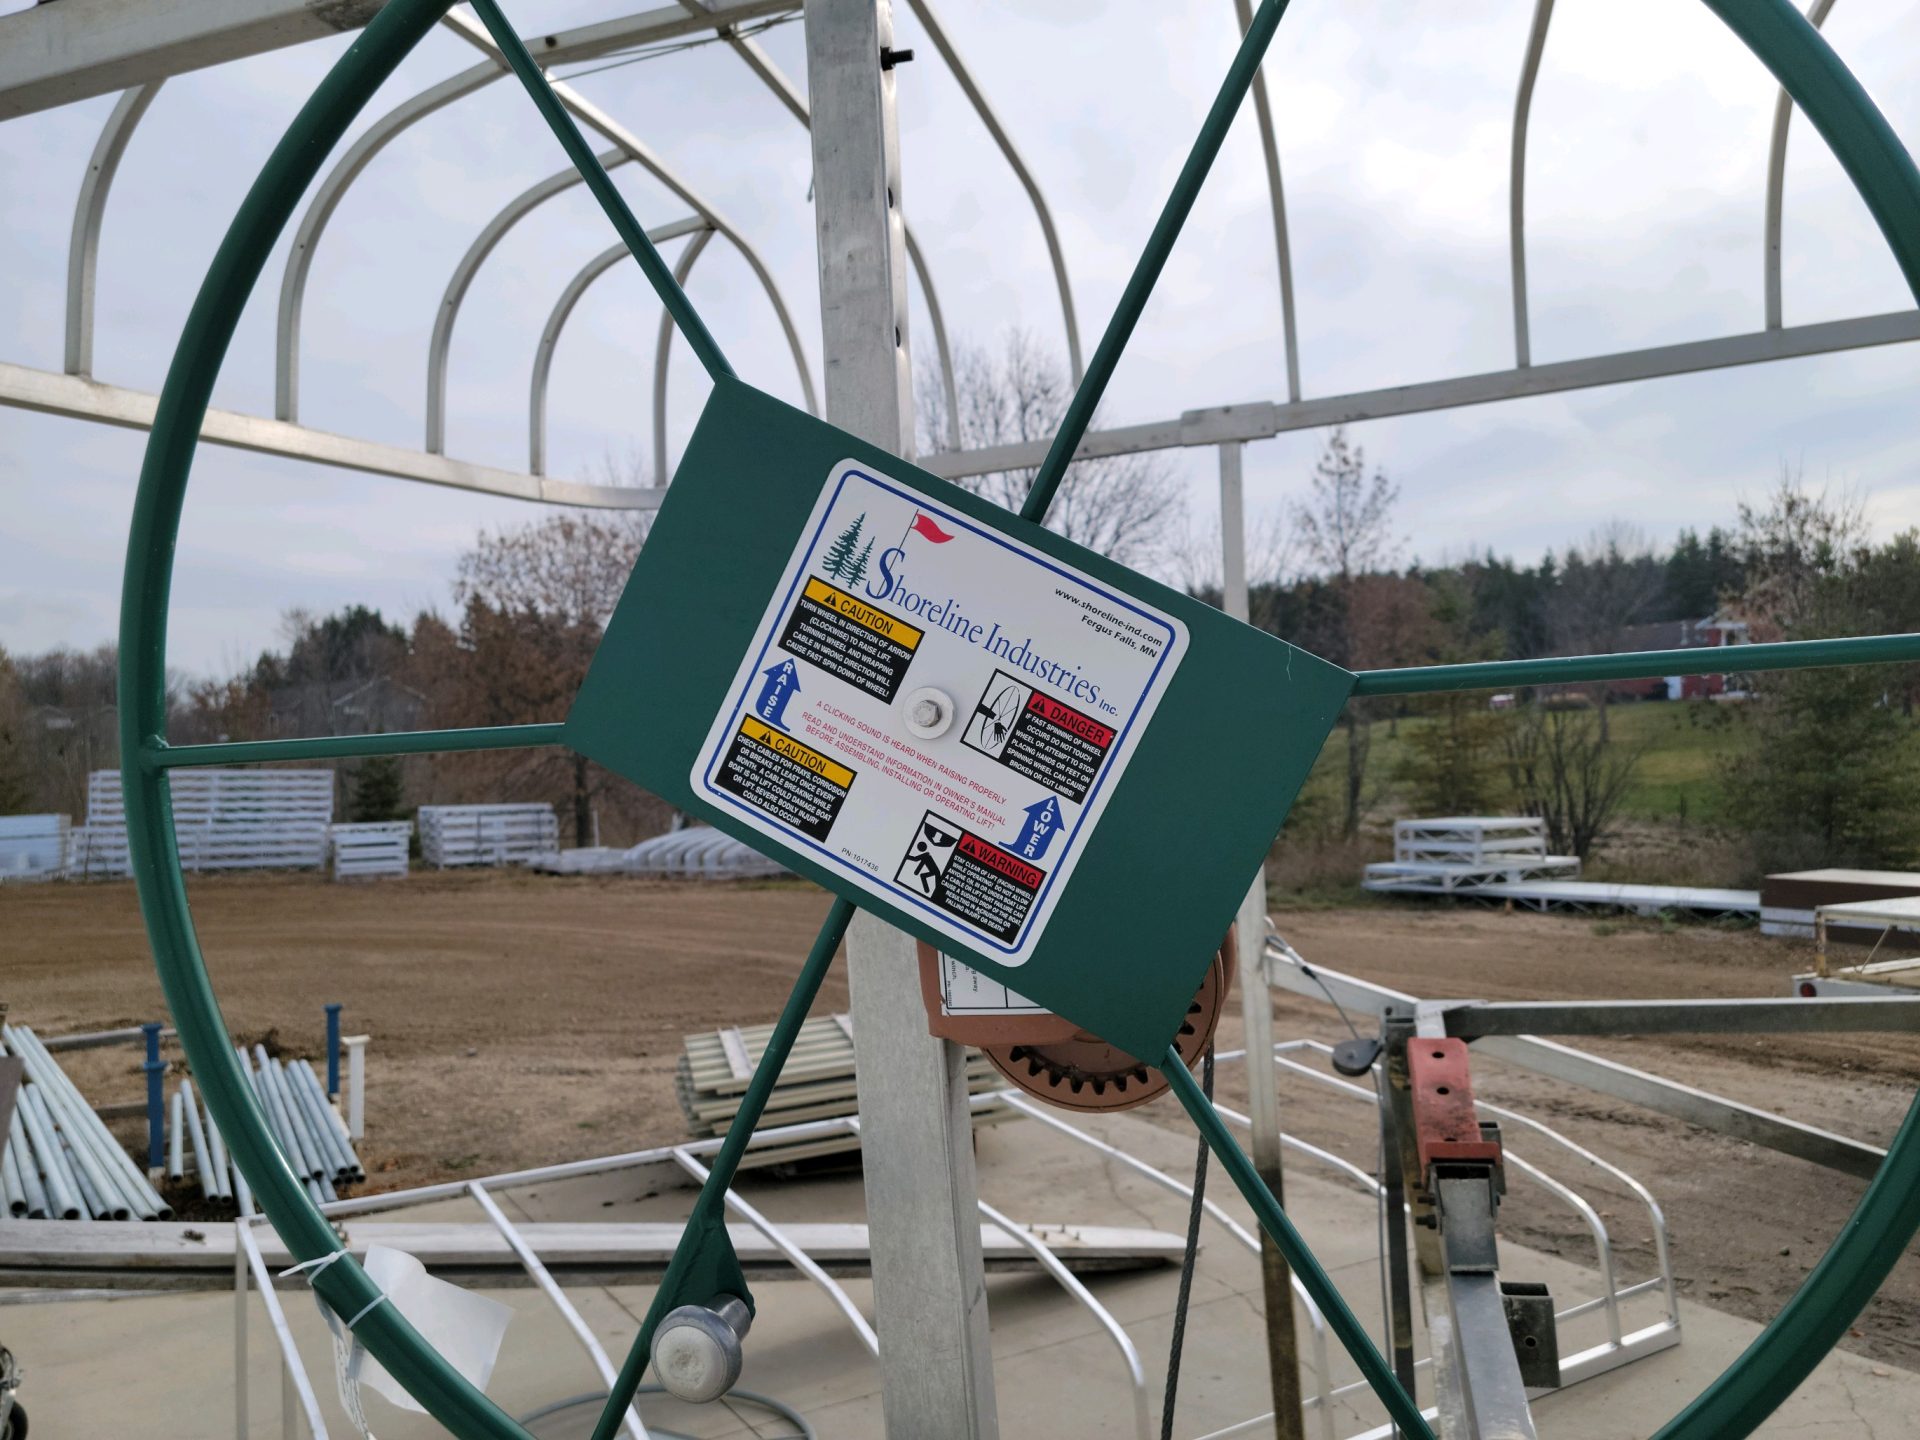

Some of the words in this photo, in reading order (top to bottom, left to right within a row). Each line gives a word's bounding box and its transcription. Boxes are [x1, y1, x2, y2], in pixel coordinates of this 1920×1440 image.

[799, 599, 817, 613] TURN
[816, 607, 839, 623] WHEEL
[837, 618, 846, 627] IN
[845, 622, 879, 644] DIRECTION
[877, 639, 888, 649] OF
[887, 643, 912, 661] ARROW
[809, 616, 849, 641] (CLOCKWISE)
[848, 636, 858, 646] TO
[857, 640, 877, 655] RAISE
[839, 598, 893, 634] CAUTION
[864, 548, 982, 643] Shoreline
[982, 623, 1101, 704] Industries
[1098, 699, 1118, 717] Inc.
[1054, 587, 1163, 646] www.shoreline-ind.com
[1080, 614, 1113, 637] Fergus
[1113, 631, 1139, 649] Falls,
[1139, 644, 1157, 658] MN
[785, 639, 807, 654] CAUSE
[806, 649, 822, 662] FAST
[821, 657, 837, 670] SPIN
[836, 665, 856, 680] DOWN
[855, 675, 865, 685] OF
[864, 679, 889, 697] WHEEL!
[792, 630, 813, 646] CABLE
[812, 641, 821, 650] IN
[820, 645, 844, 662] WRONG
[843, 657, 876, 678] DIRECTION
[875, 673, 891, 686] WILL
[798, 622, 826, 641] TURNING
[825, 636, 847, 652] WHEEL
[847, 647, 861, 659] AND
[860, 654, 894, 676] WRAPPING
[763, 662, 794, 717] RAISE
[815, 699, 822, 708] A
[822, 703, 856, 726] CLICKING
[855, 720, 882, 739] SOUND
[881, 734, 890, 744] IS
[889, 738, 916, 757] HEARD
[915, 752, 938, 769] WHEN
[937, 763, 968, 785] RAISING
[1014, 729, 1035, 744] WHEEL
[1034, 739, 1044, 748] OR
[1044, 744, 1071, 762] ATTEMPT
[1069, 757, 1079, 766] TO
[1024, 712, 1032, 720] IF
[1031, 716, 1046, 727] FAST
[1045, 723, 1073, 741] SPINNING
[1072, 737, 1082, 746] OF
[1081, 741, 1102, 756] WHEEL
[1026, 724, 1050, 741] OCCURS
[1050, 736, 1060, 746] DO
[1059, 741, 1072, 752] NOT
[1071, 747, 1092, 762] TOUCH
[1049, 706, 1105, 743] DANGER
[736, 734, 757, 750] CHECK
[756, 745, 780, 762] CABLES
[779, 757, 793, 769] FOR
[791, 764, 812, 780] FRAYS,
[811, 774, 846, 798] CORROSION
[739, 746, 749, 756] OR
[749, 751, 773, 769] BREAKS
[772, 764, 781, 773] AT
[780, 768, 799, 783] LEAST
[798, 778, 816, 792] ONCE
[814, 787, 835, 803] EVERY
[773, 737, 826, 773] CAUTION
[801, 711, 822, 727] READ
[821, 722, 838, 735] AND
[837, 730, 885, 760] UNDERSTAND
[884, 755, 933, 786] INFORMATION
[933, 781, 942, 791] IN
[942, 785, 976, 809] OWNER'S
[975, 803, 1007, 825] MANUAL
[804, 724, 834, 745] BEFORE
[833, 739, 881, 770] ASSEMBLING,
[880, 764, 923, 792] INSTALLING
[922, 787, 935, 798] OR
[934, 793, 976, 820] OPERATING
[975, 815, 994, 830] LIFT!
[1006, 747, 1033, 765] SPINNING
[1032, 760, 1053, 775] WHEEL
[1052, 771, 1066, 782] CAN
[1065, 777, 1086, 792] CAUSE
[1009, 759, 1033, 776] BROKEN
[1032, 771, 1042, 780] OR
[1042, 776, 1055, 787] CUT
[1054, 782, 1074, 797] LIMBS!
[1011, 738, 1036, 755] PLACING
[1035, 751, 1056, 765] HANDS
[1055, 761, 1065, 770] OR
[1065, 766, 1080, 778] FEET
[1079, 774, 1090, 783] ON
[727, 760, 744, 773] BOAT
[743, 768, 750, 777] IS
[749, 772, 759, 782] ON
[758, 777, 772, 789] LIFT
[771, 784, 791, 799] COULD
[791, 795, 816, 813] DAMAGE
[815, 808, 831, 821] BOAT
[732, 773, 742, 783] OR
[754, 785, 778, 803] SEVERE
[777, 798, 798, 814] BODILY
[797, 809, 819, 825] INJURY
[735, 754, 758, 771] MONTH.
[758, 767, 765, 775] A
[764, 770, 784, 785] CABLE
[783, 780, 813, 801] BREAKING
[812, 796, 831, 811] WHILE
[742, 789, 762, 805] COULD
[761, 800, 779, 814] ALSO
[777, 808, 801, 826] OCCUR!
[1023, 800, 1056, 856] LOWER
[977, 846, 1037, 885] WARNING
